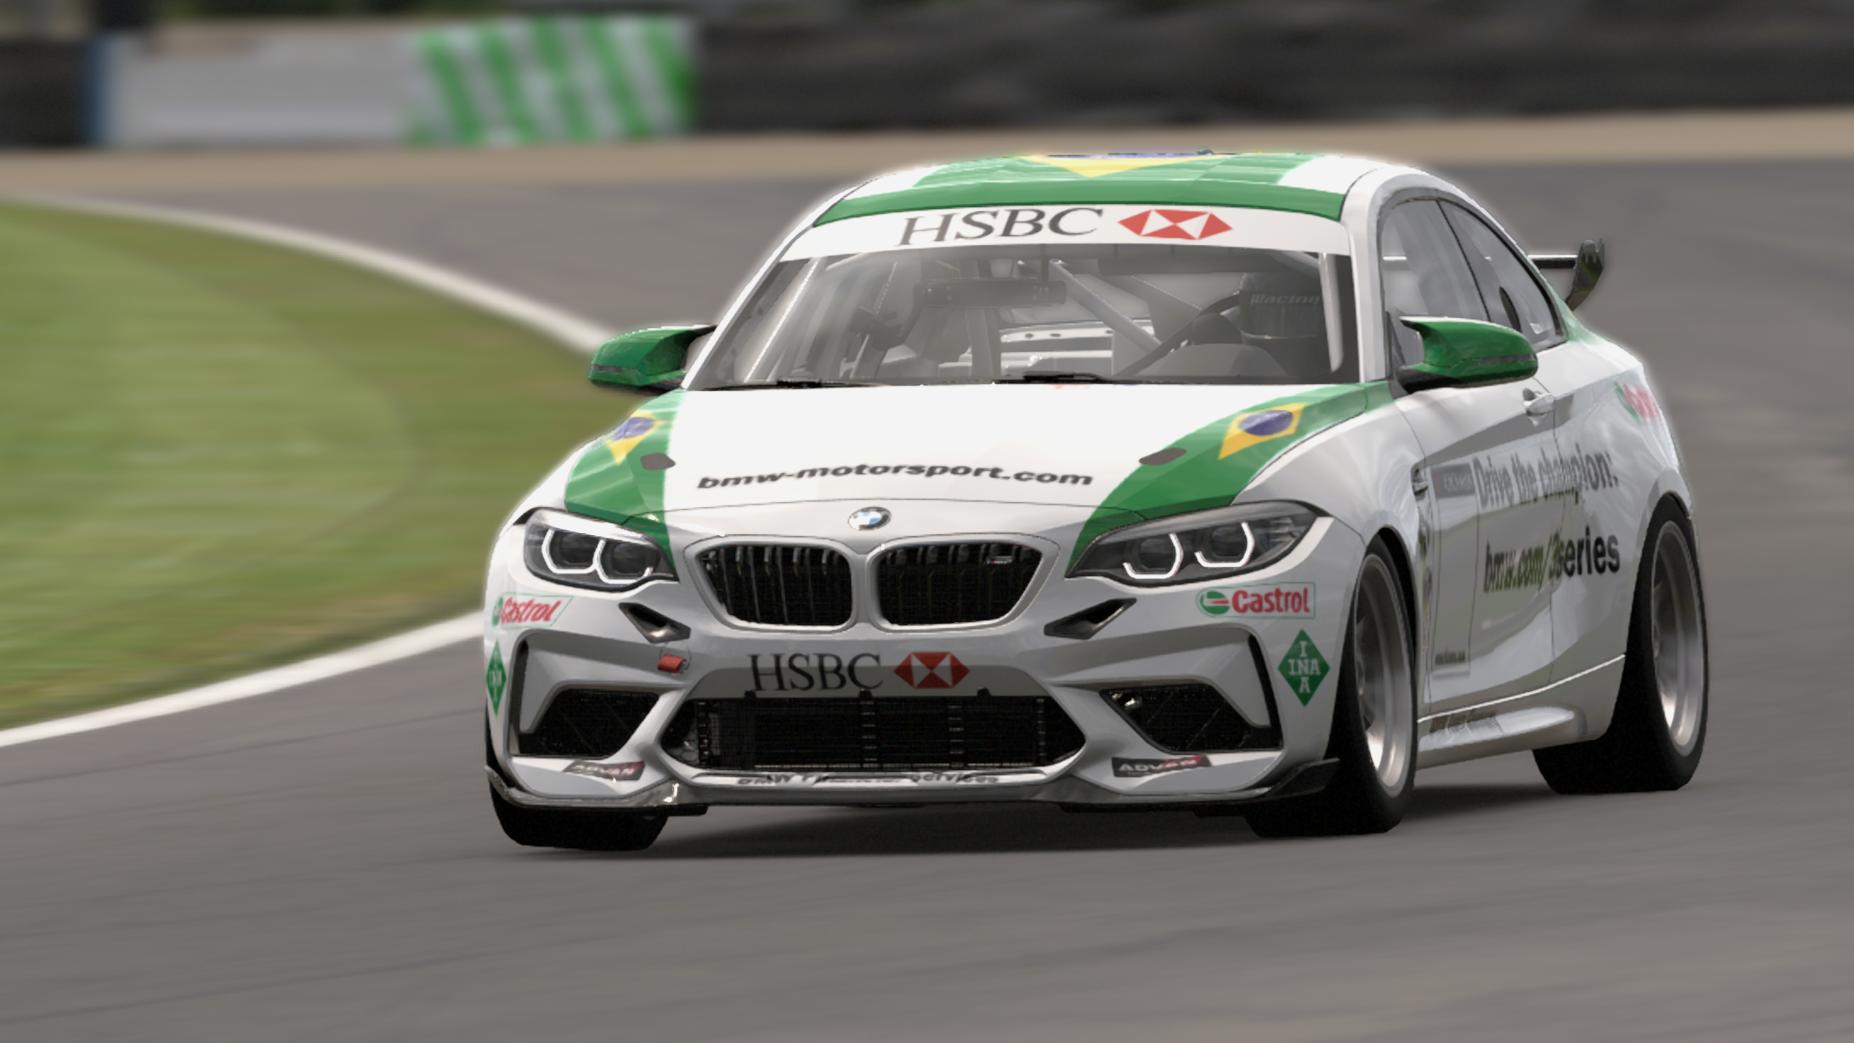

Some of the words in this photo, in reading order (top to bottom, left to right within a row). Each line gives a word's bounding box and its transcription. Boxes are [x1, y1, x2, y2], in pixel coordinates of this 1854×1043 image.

[897, 207, 1103, 246] HSBC
[697, 464, 1093, 489] bmw-motorsport.com
[1473, 456, 1514, 508] Drive
[1511, 453, 1540, 504] the
[501, 597, 561, 625] Castrol
[1231, 588, 1310, 614] Castrol
[747, 652, 883, 691] HSBC
